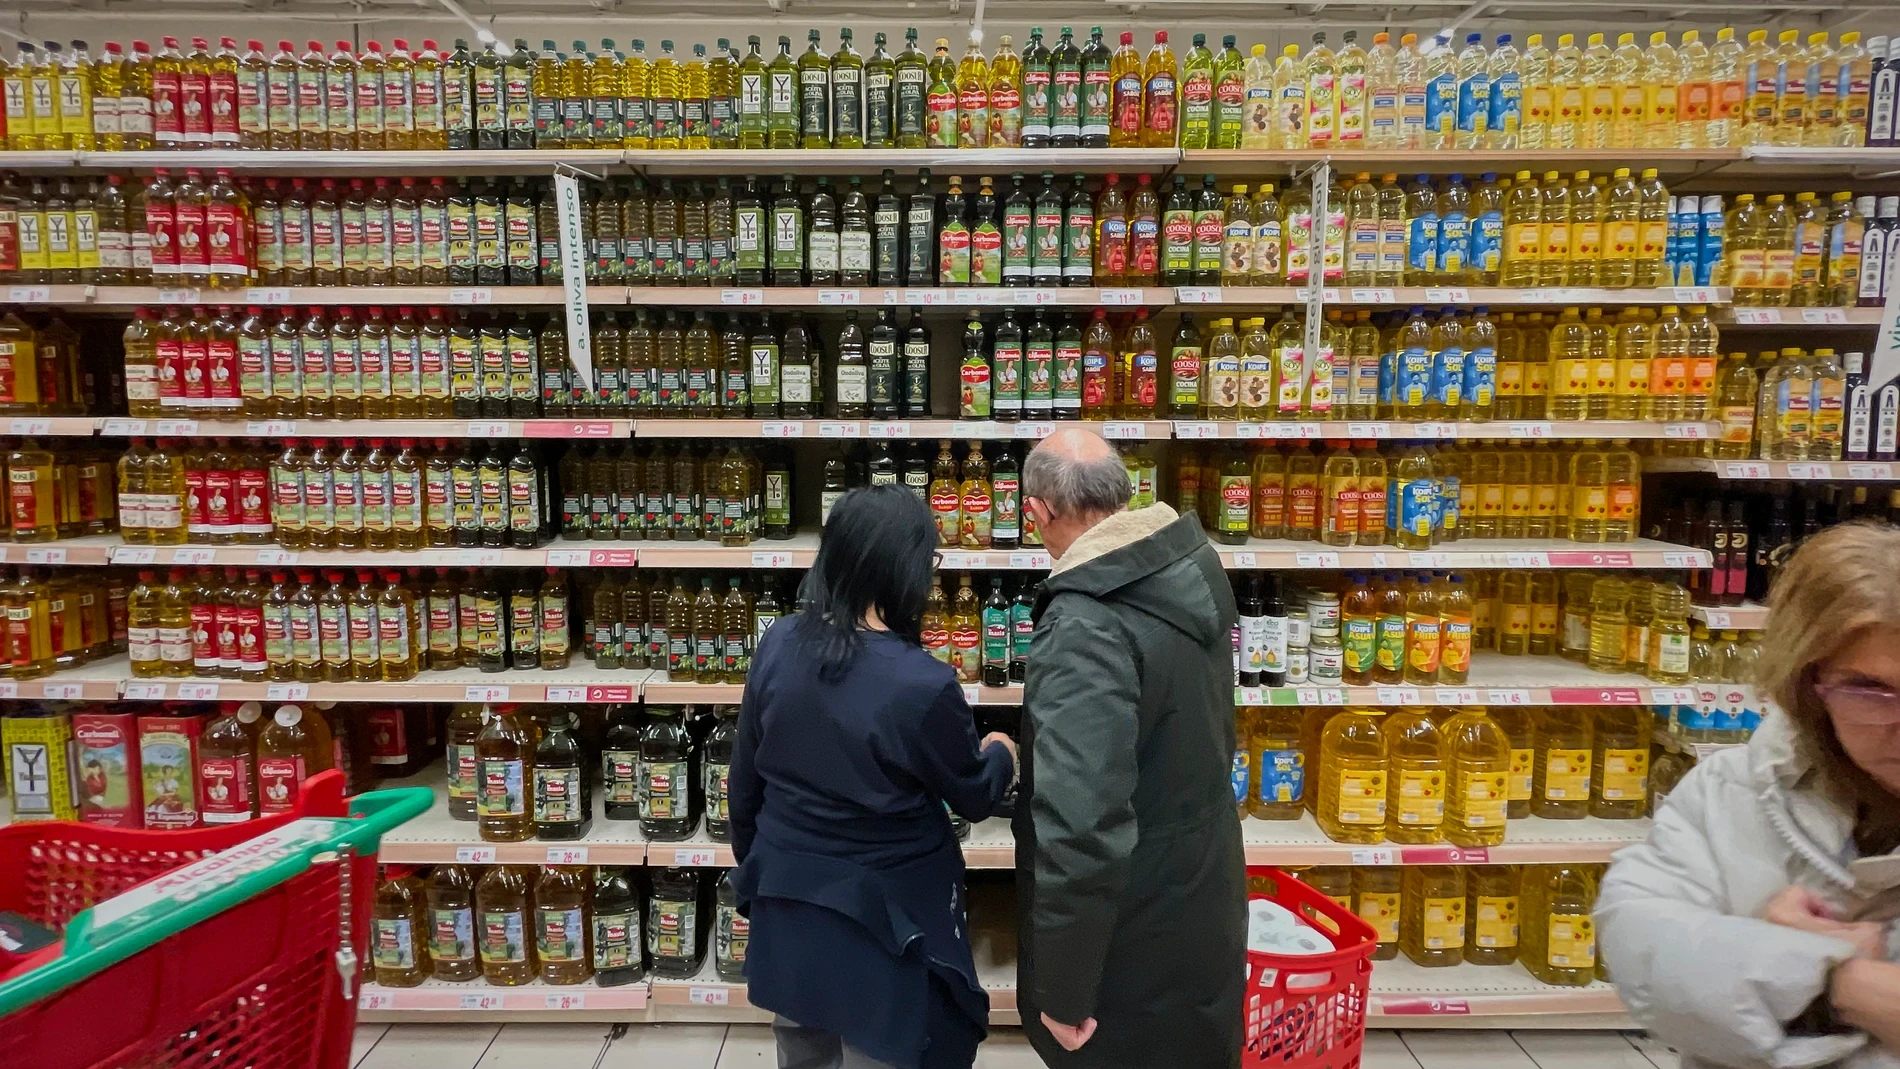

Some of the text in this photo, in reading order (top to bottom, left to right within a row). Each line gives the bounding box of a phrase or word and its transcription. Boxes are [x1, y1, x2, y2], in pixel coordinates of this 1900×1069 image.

[1152, 81, 1174, 90] KOIPE
[1313, 87, 1331, 97] soy
[1344, 86, 1361, 97] soy
[565, 187, 580, 273] intenso
[1443, 221, 1467, 231] KOIPE
[1229, 228, 1249, 236] KOIPE
[1291, 228, 1308, 238] soy
[1446, 230, 1464, 240] SOL
[1168, 245, 1190, 253] COCINA
[1308, 182, 1323, 345] aceite girasol
[572, 277, 585, 326] oliva
[1248, 362, 1268, 371] KOIPE
[1282, 360, 1300, 371] soy
[1313, 360, 1331, 371] soy
[1407, 363, 1426, 373] SOL
[1476, 363, 1494, 373] SOL
[1176, 381, 1198, 389] COCINA
[931, 498, 959, 506] Carbonell
[962, 499, 990, 507] Carbonell
[1349, 623, 1371, 633] KOIPE
[77, 729, 120, 739] Carbonell
[153, 836, 281, 894] Alcampo
